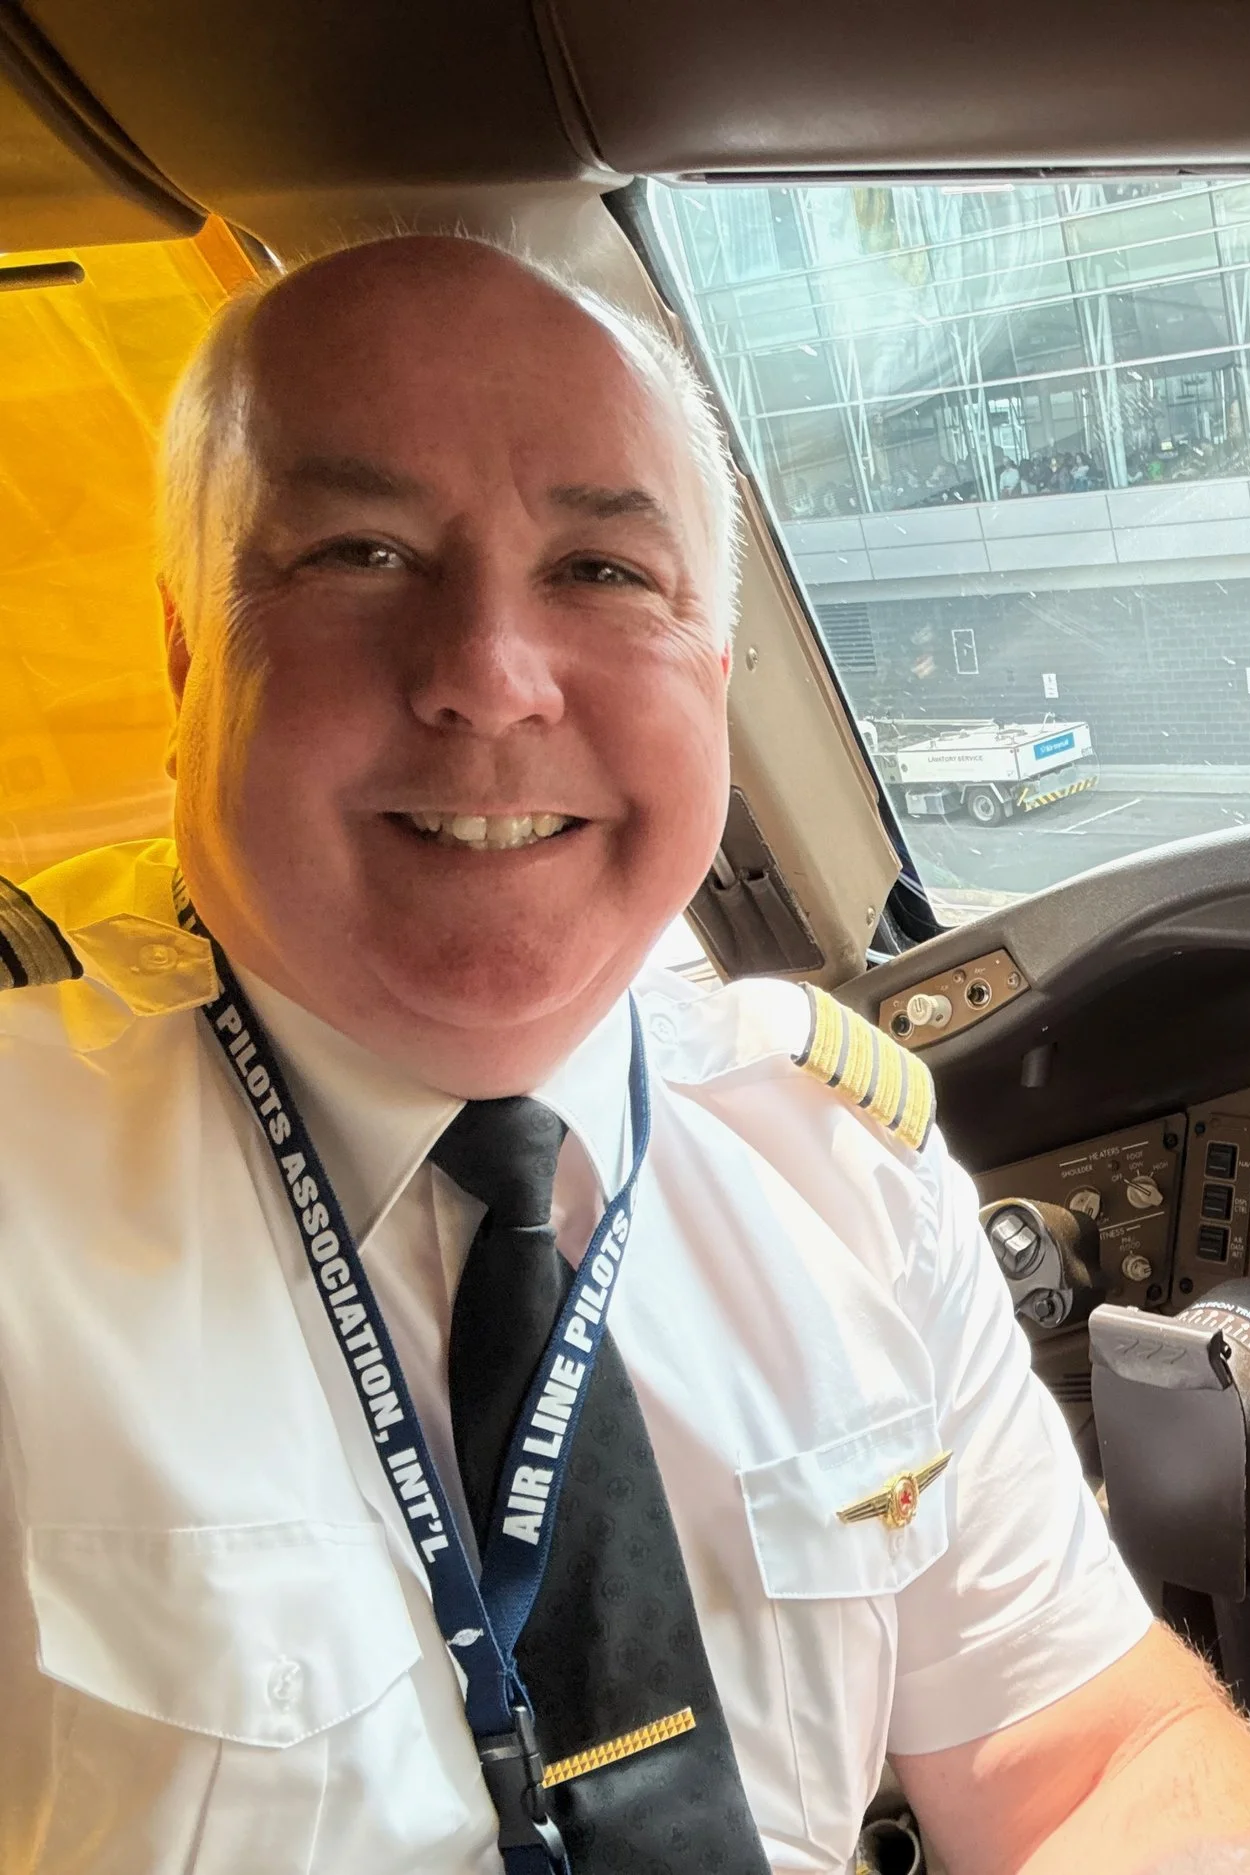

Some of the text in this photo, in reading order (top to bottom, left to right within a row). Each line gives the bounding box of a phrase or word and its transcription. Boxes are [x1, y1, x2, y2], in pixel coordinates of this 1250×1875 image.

[957, 755, 984, 766] SERVICE
[1089, 1147, 1120, 1161] HEATERS
[1061, 1163, 1093, 1179] SHOULDER
[216, 1002, 449, 1564] PILOTS ASSOCIATION, INT'L
[502, 1208, 630, 1545] AIR LINE PILOTS
